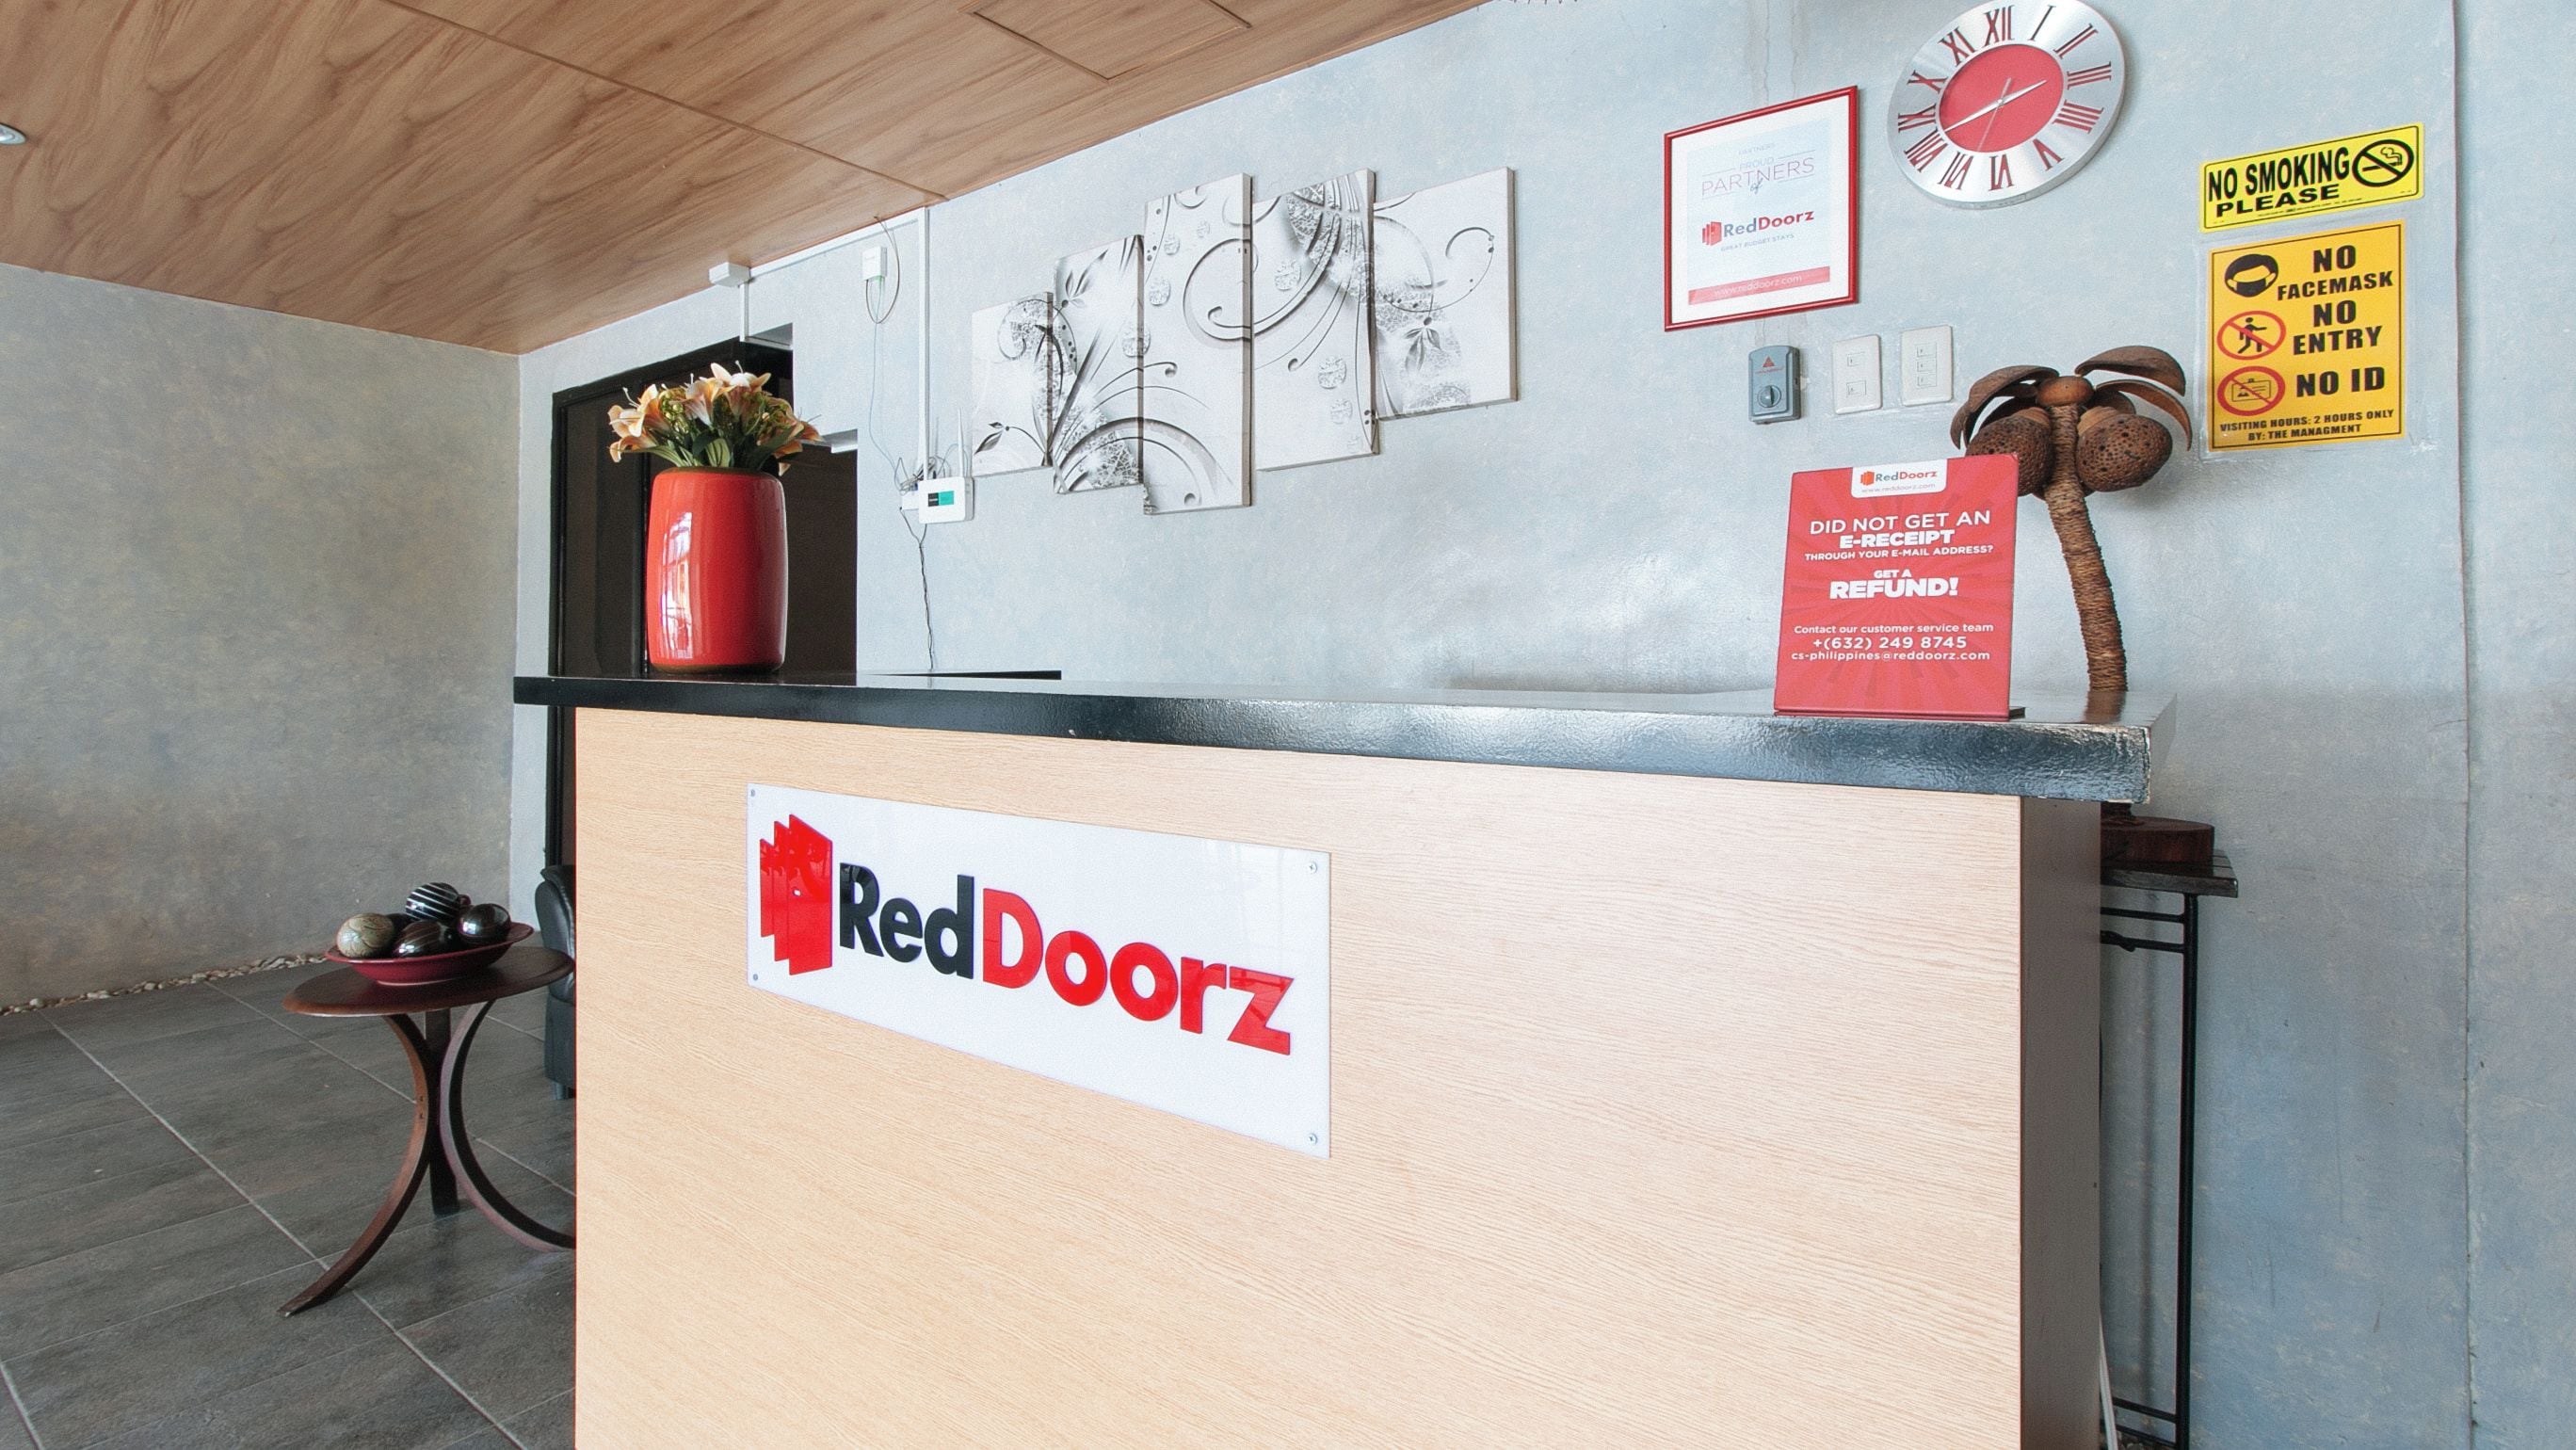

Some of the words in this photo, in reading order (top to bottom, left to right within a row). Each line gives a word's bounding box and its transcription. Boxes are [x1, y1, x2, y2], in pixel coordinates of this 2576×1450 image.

[1983, 5, 2015, 47] XII
[2027, 5, 2056, 41] I
[1938, 26, 1977, 67] XI
[2053, 23, 2099, 59] II
[1907, 70, 1948, 94] X
[2067, 61, 2112, 90] III
[1897, 103, 1937, 133] IX
[2052, 99, 2104, 135] IIII
[1903, 128, 1949, 173] VIII
[2032, 138, 2064, 171] V
[1701, 157, 1814, 196] PARTNERS
[1938, 152, 1974, 190] VII
[1988, 153, 2015, 191] VI
[2208, 167, 2238, 201] NO
[2245, 147, 2350, 196] SMOKING
[2216, 184, 2340, 218] PLEASE
[1724, 211, 1814, 237] RedDoorz
[1772, 234, 1795, 242] STAYS
[2313, 245, 2357, 273] NO
[1714, 275, 1803, 296] www.reddoorz.com
[2278, 270, 2393, 301] FACEMASK
[2313, 299, 2357, 328] NO
[2294, 326, 2383, 355] ENTRY
[2296, 371, 2339, 397] NO
[2351, 366, 2385, 394] ID
[2220, 419, 2267, 432] VISITING
[2270, 416, 2311, 428] HOURS:
[2313, 415, 2321, 425] 2
[2325, 411, 2363, 423] HOURS
[2366, 409, 2394, 420] ONLY
[2247, 432, 2265, 442] BY:
[2269, 429, 2289, 440] THE
[2291, 424, 2361, 438] MANAGMENT
[1876, 471, 1938, 482] RedDoorz
[1810, 519, 1846, 535] DID
[1853, 516, 1898, 532] NOT
[1905, 512, 1949, 530] GET
[1956, 509, 1990, 526] AN
[1805, 552, 1856, 561] THROUGH
[1859, 549, 1889, 559] YOUR
[1891, 548, 1929, 557] E-MAIL
[1933, 545, 1994, 556] ADDRESS?
[1839, 529, 1956, 549] E-RECEIPT
[1829, 577, 1958, 600] REFUND!
[1874, 569, 1900, 579] GET
[1901, 569, 1912, 578] A
[1794, 624, 1837, 635] Contact
[1839, 626, 1858, 635] our
[1860, 623, 1914, 634] customer
[1917, 623, 1959, 633] service
[1962, 623, 1994, 633] team
[1812, 636, 1872, 650] +(632)
[1879, 636, 1914, 649] 249
[1920, 636, 1968, 649] 8745
[1792, 651, 1990, 663] cs-philippines@reddoorz.com
[839, 862, 1295, 1056] RedDoorz
